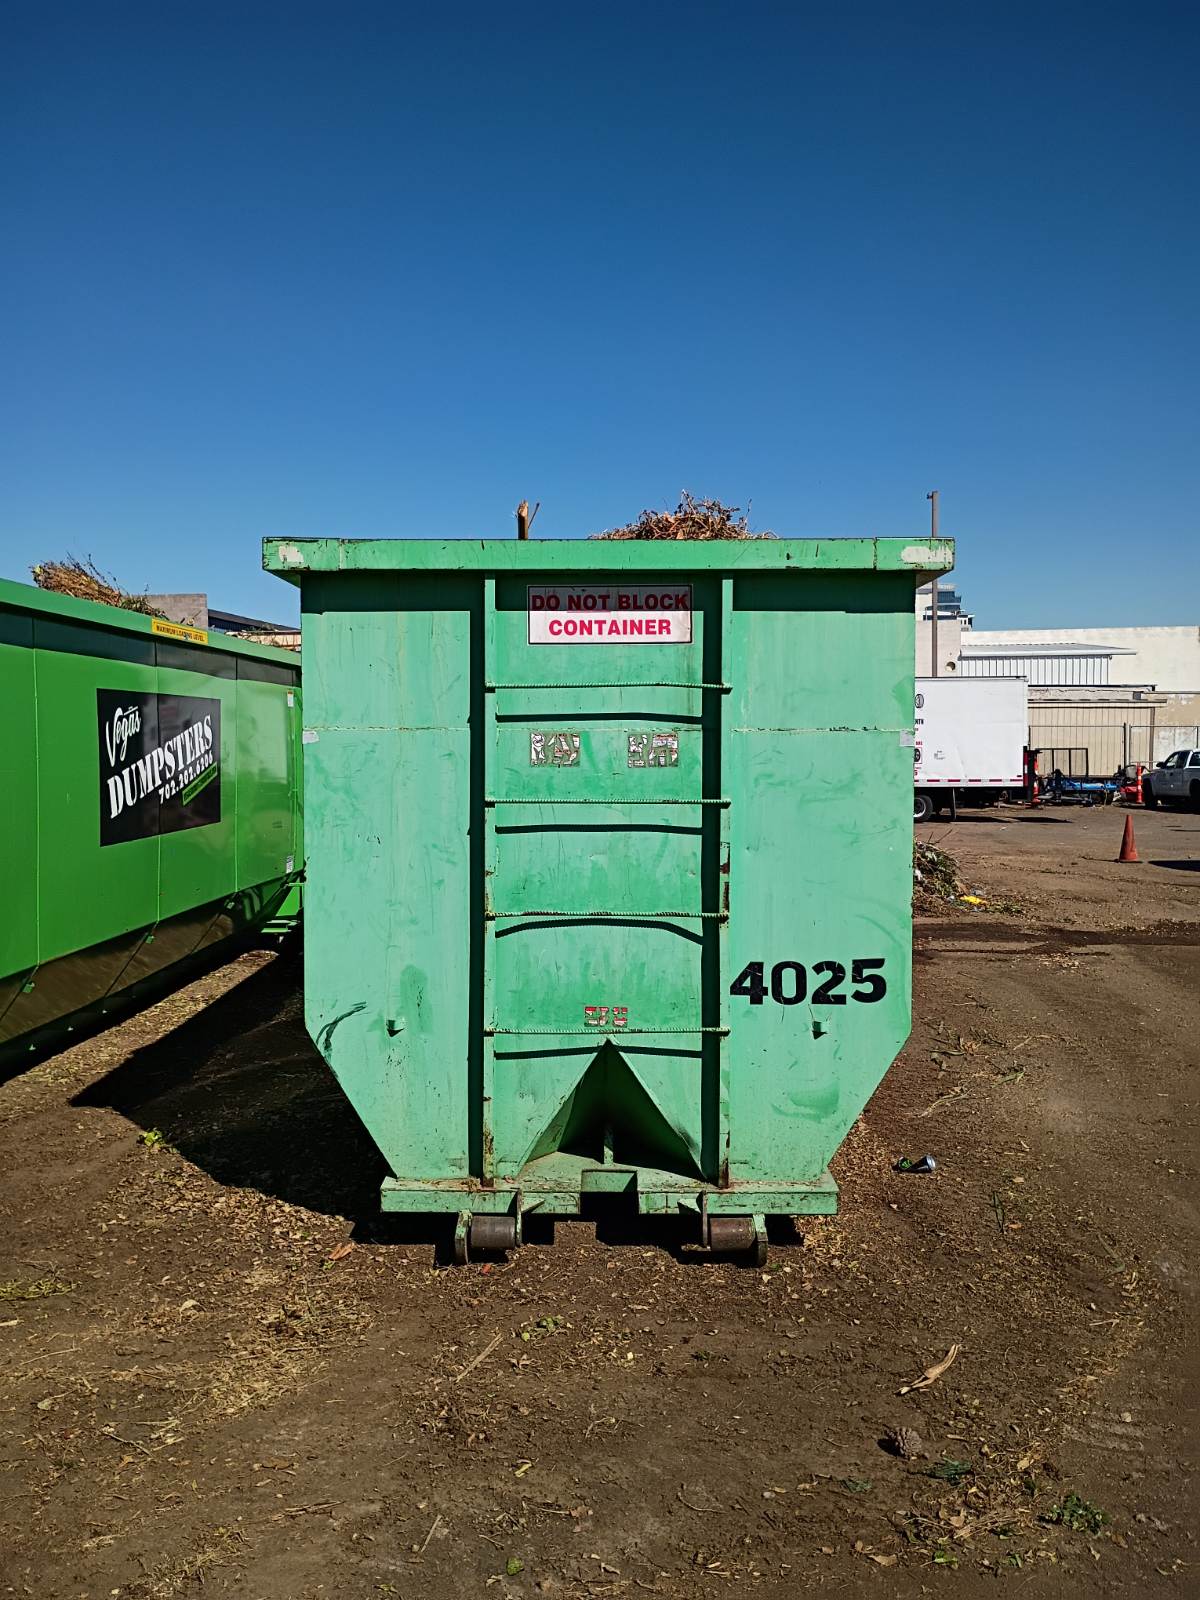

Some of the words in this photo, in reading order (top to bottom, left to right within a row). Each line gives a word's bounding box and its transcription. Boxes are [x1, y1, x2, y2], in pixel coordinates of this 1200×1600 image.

[531, 594, 560, 611] DO
[567, 594, 611, 611] NOT
[618, 593, 689, 610] BLOCK
[548, 619, 672, 636] CONTAINER
[105, 706, 141, 767] Vegas
[107, 714, 213, 819] DUMPSTERS
[158, 750, 213, 805] 702.202.6206
[729, 958, 887, 1006] 4025
